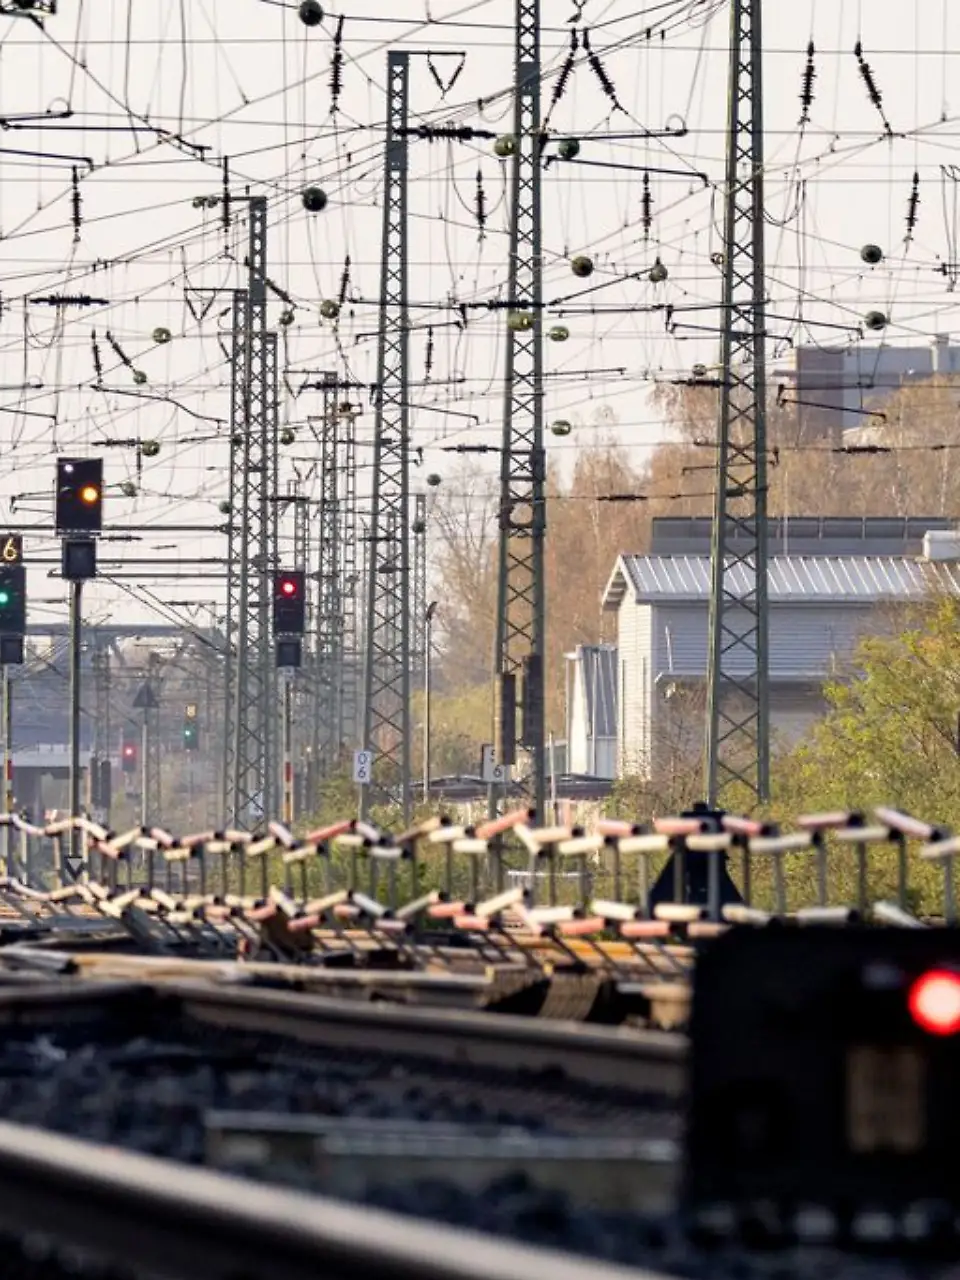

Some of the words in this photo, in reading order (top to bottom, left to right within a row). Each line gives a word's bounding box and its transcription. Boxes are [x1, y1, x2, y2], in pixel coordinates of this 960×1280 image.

[3, 537, 17, 560] 6
[358, 766, 366, 778] 6
[493, 764, 502, 778] 6
